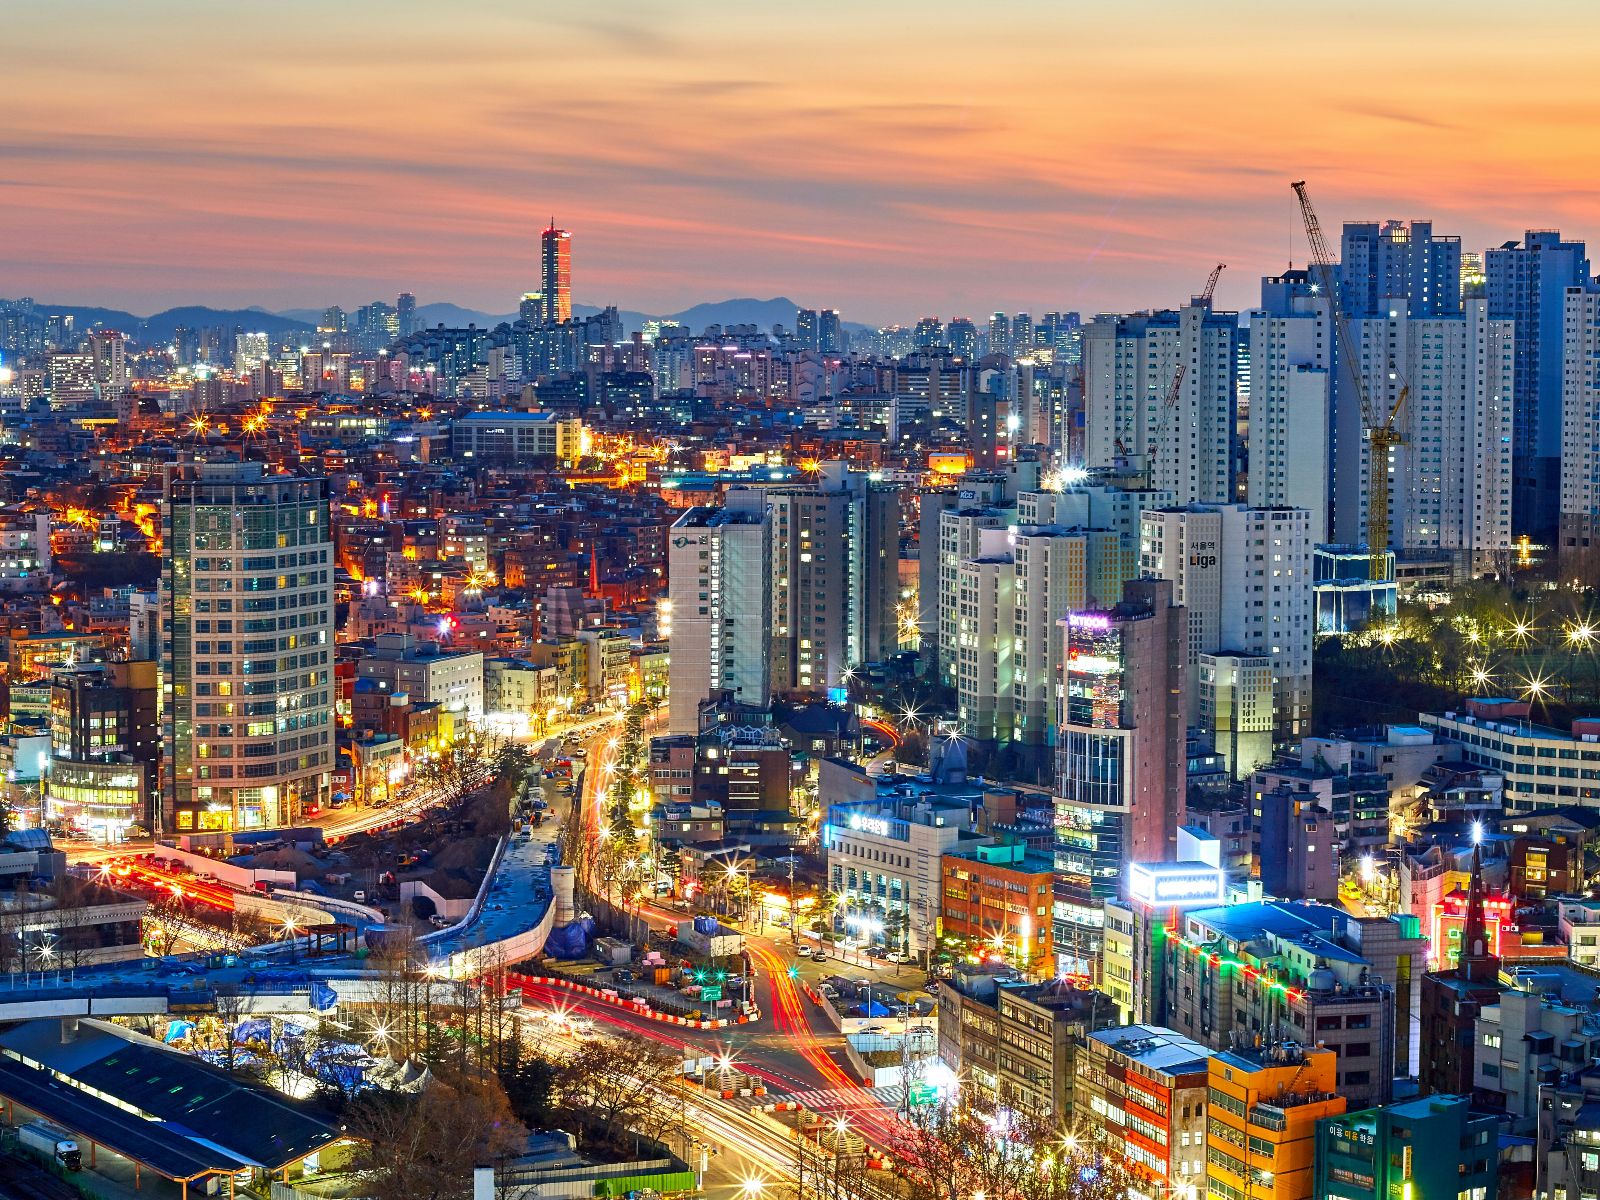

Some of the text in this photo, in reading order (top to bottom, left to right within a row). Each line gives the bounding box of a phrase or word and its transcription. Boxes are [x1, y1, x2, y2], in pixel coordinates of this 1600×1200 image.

[960, 491, 974, 499] KCC
[1191, 541, 1215, 550] 서울역
[1190, 553, 1216, 568] Liga
[861, 817, 888, 836] 우리은
[1329, 1126, 1374, 1145] 이용 미용 학원
